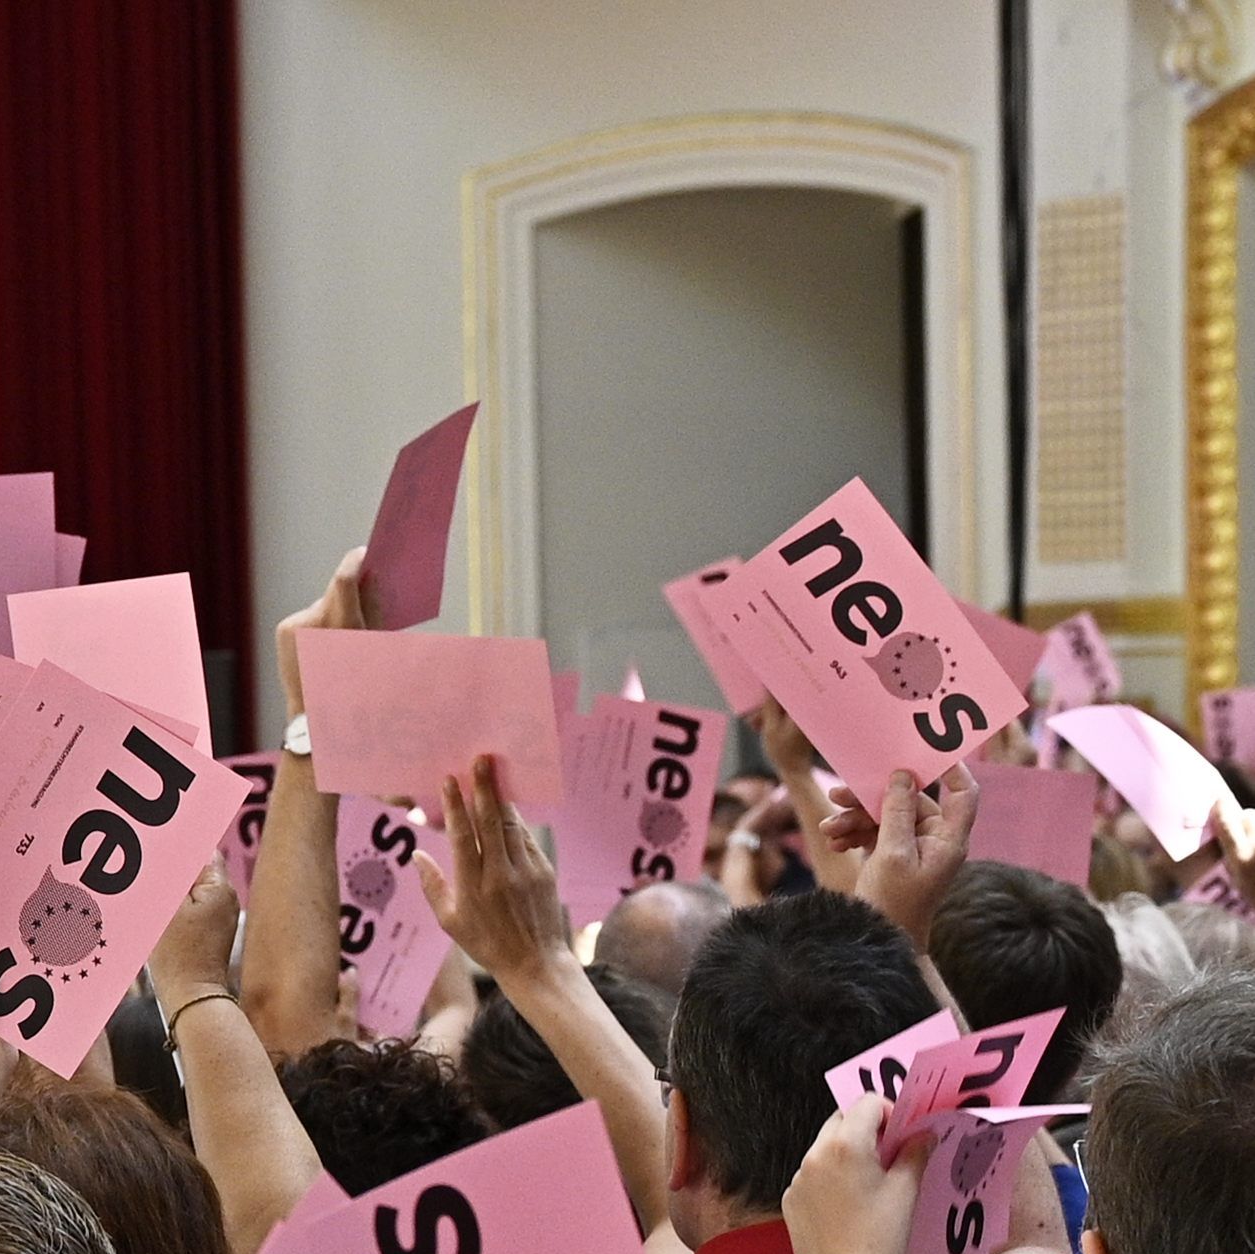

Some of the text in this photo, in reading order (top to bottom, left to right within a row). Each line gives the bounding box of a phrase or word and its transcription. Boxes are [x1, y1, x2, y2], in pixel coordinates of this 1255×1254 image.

[778, 517, 989, 753] neos
[829, 659, 849, 681] 943
[15, 833, 35, 857] 733
